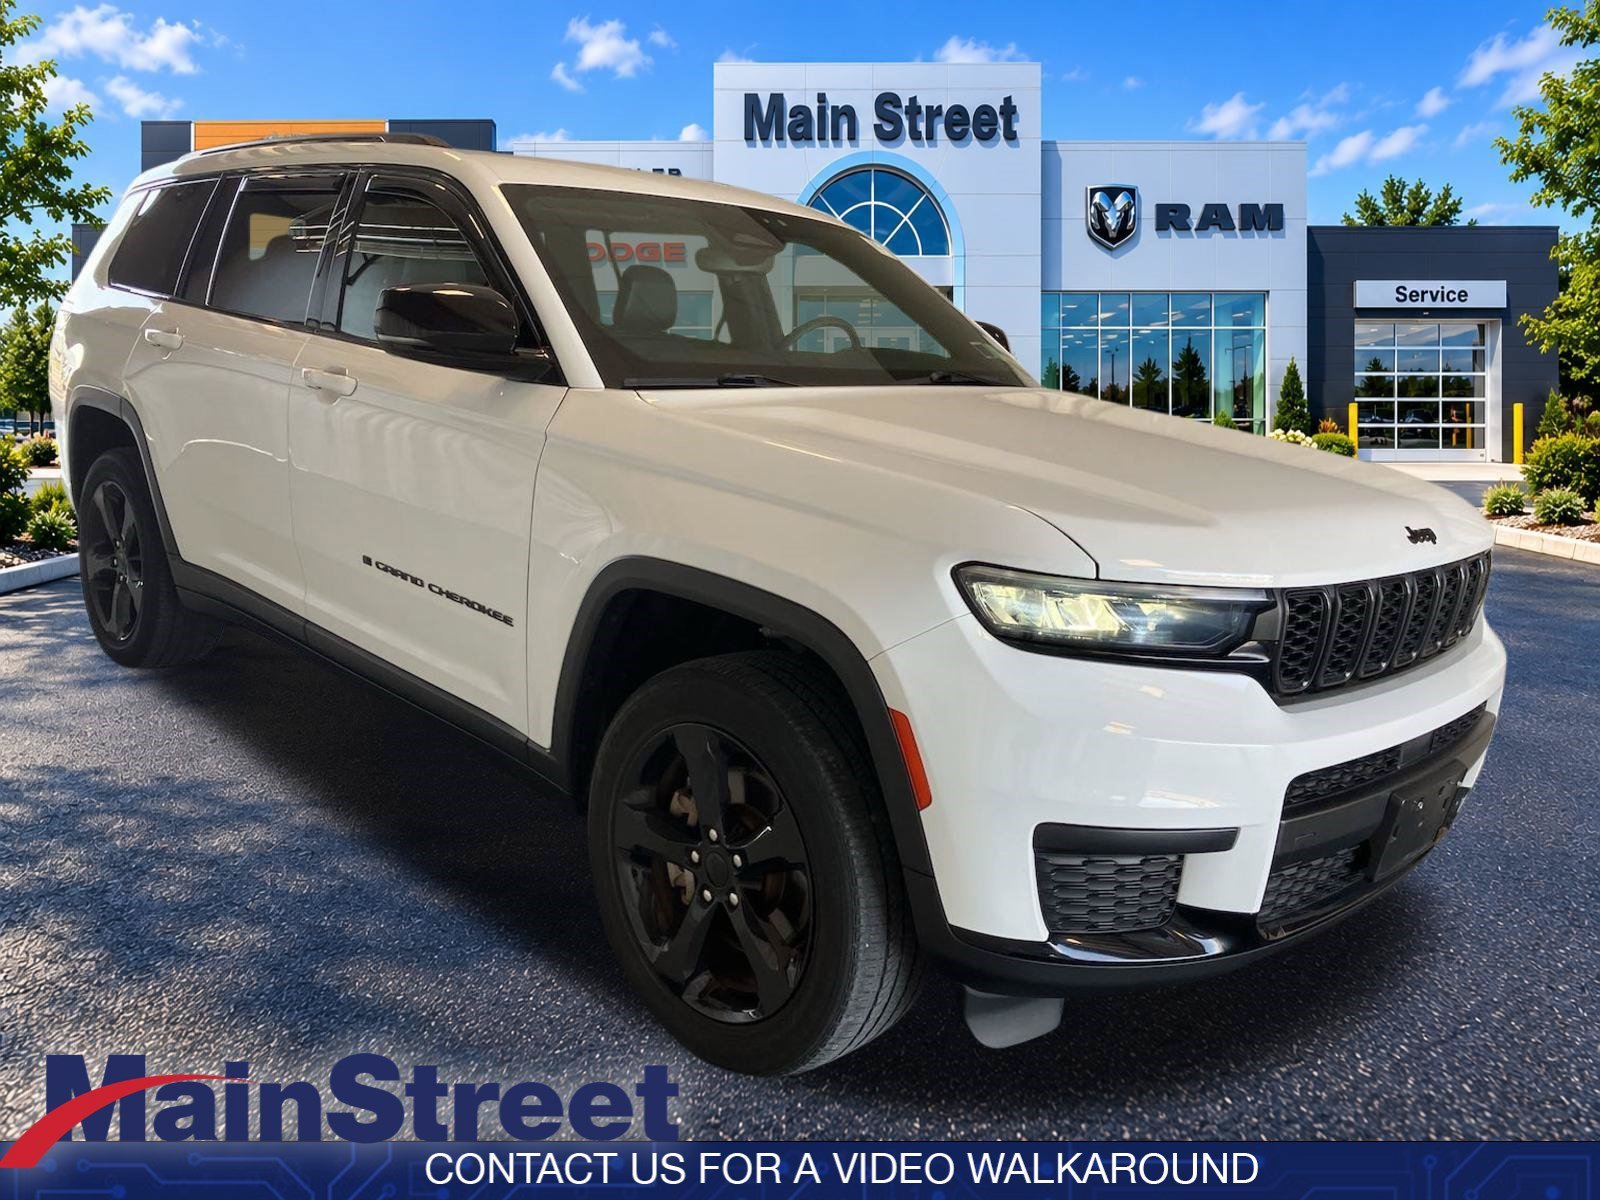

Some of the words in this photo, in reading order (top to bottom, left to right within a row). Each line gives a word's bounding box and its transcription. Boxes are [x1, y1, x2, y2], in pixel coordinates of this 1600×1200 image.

[743, 92, 857, 143] Main
[872, 91, 1018, 143] Street
[1155, 203, 1284, 232] RAM
[585, 242, 686, 262] ODGE
[1394, 285, 1469, 304] Service
[374, 560, 425, 588] GRAND
[427, 582, 514, 628] CHEROKEE
